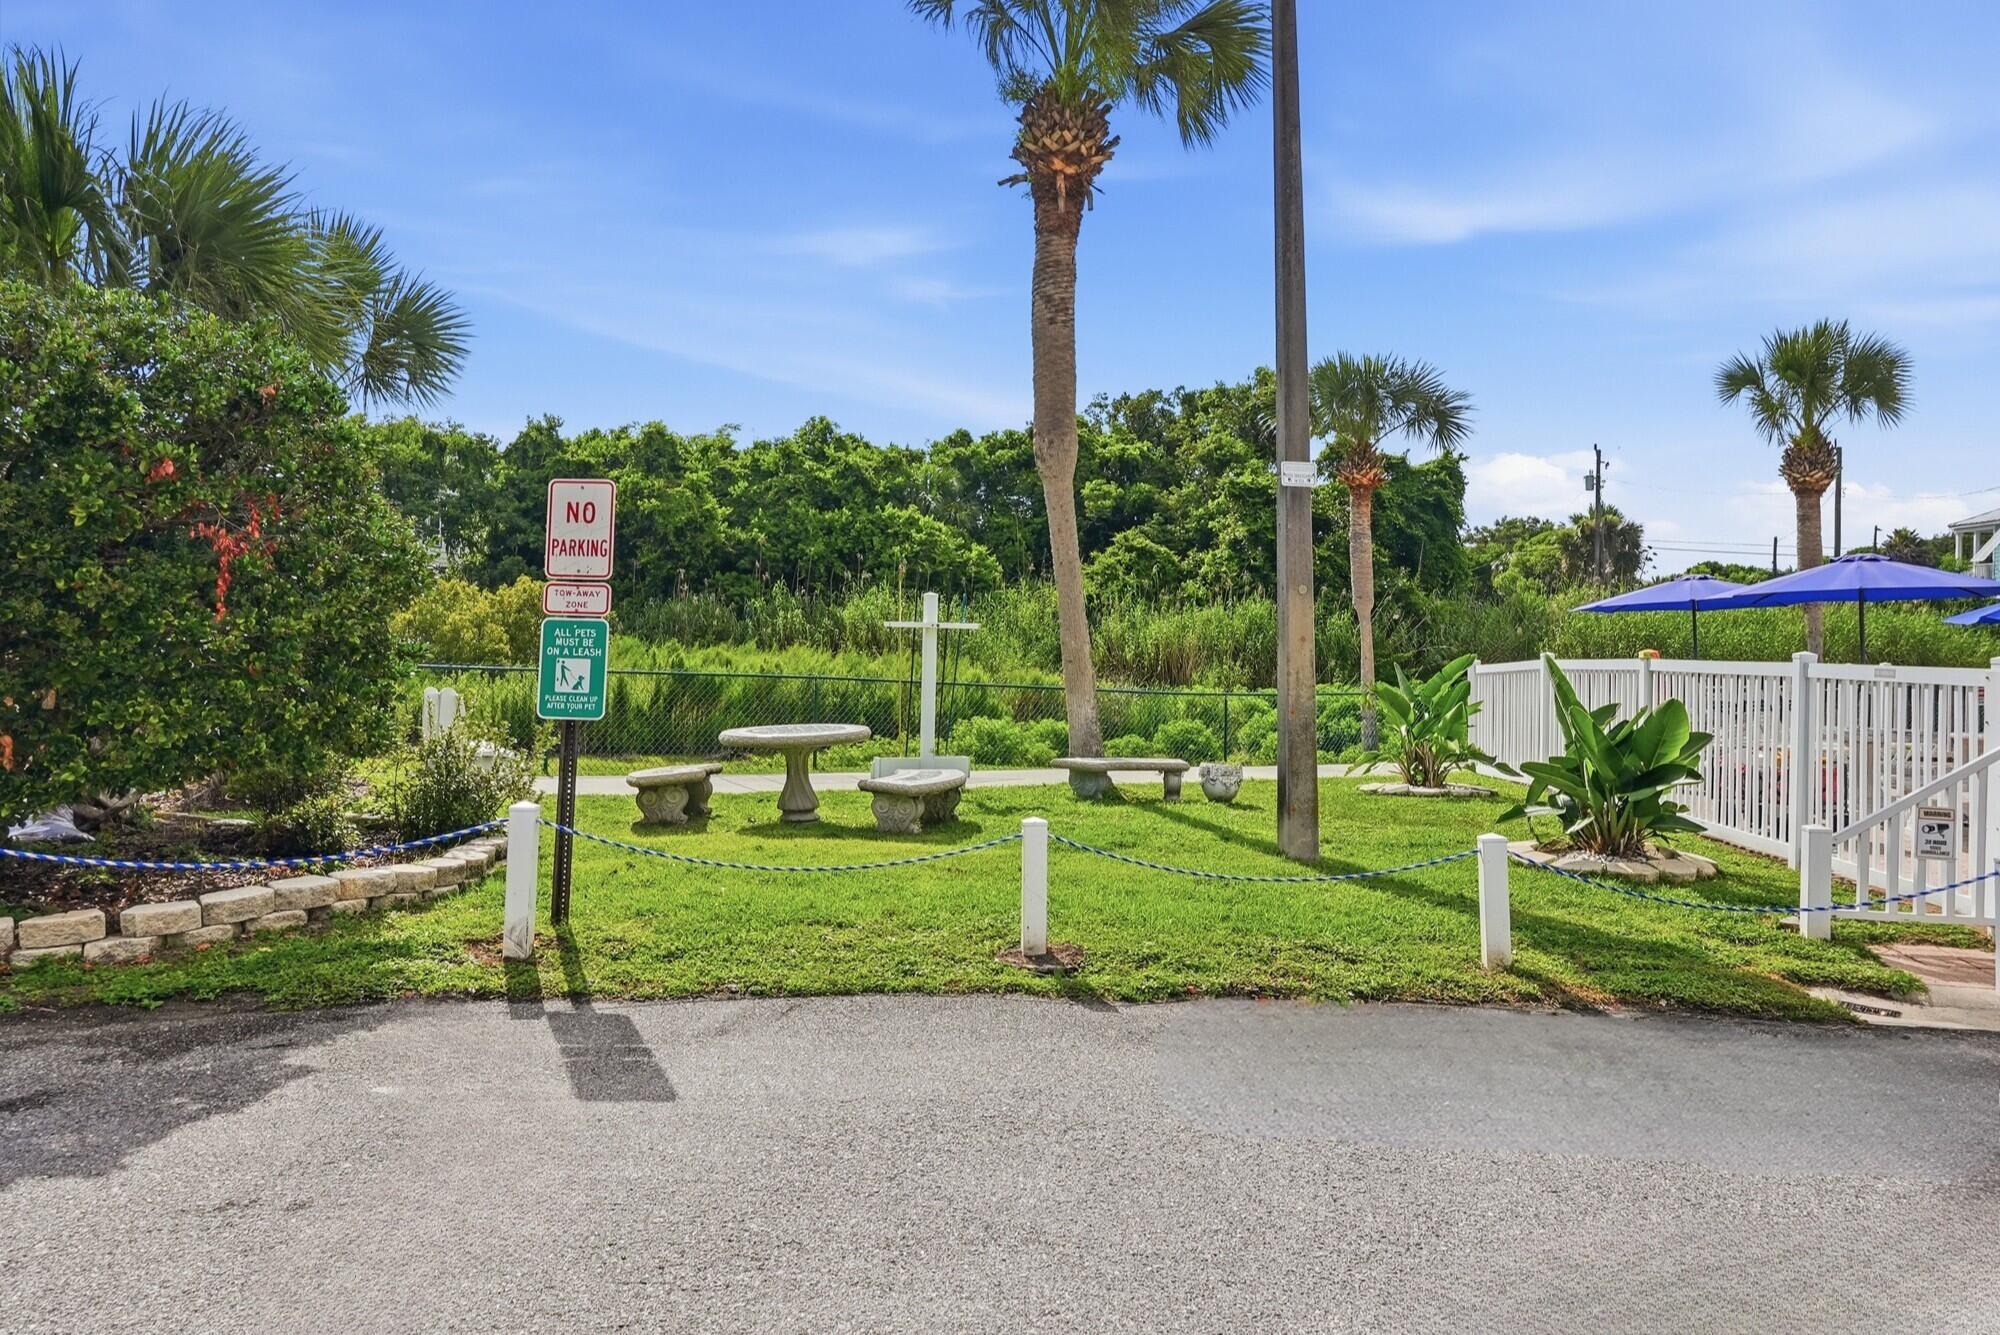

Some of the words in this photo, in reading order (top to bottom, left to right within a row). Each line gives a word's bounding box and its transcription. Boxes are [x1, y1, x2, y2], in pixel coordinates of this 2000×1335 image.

[566, 501, 596, 524] NO
[551, 538, 608, 558] PARKING
[555, 589, 600, 597] TOW-AWAY
[554, 628, 571, 637] ALL
[575, 629, 597, 638] PETS
[556, 637, 579, 647] MUST
[583, 638, 594, 647] BE
[547, 646, 560, 656] ON
[563, 647, 570, 656] A
[573, 647, 602, 657] LEASH
[545, 694, 567, 702] PLEASE
[569, 695, 588, 703] CLEAN
